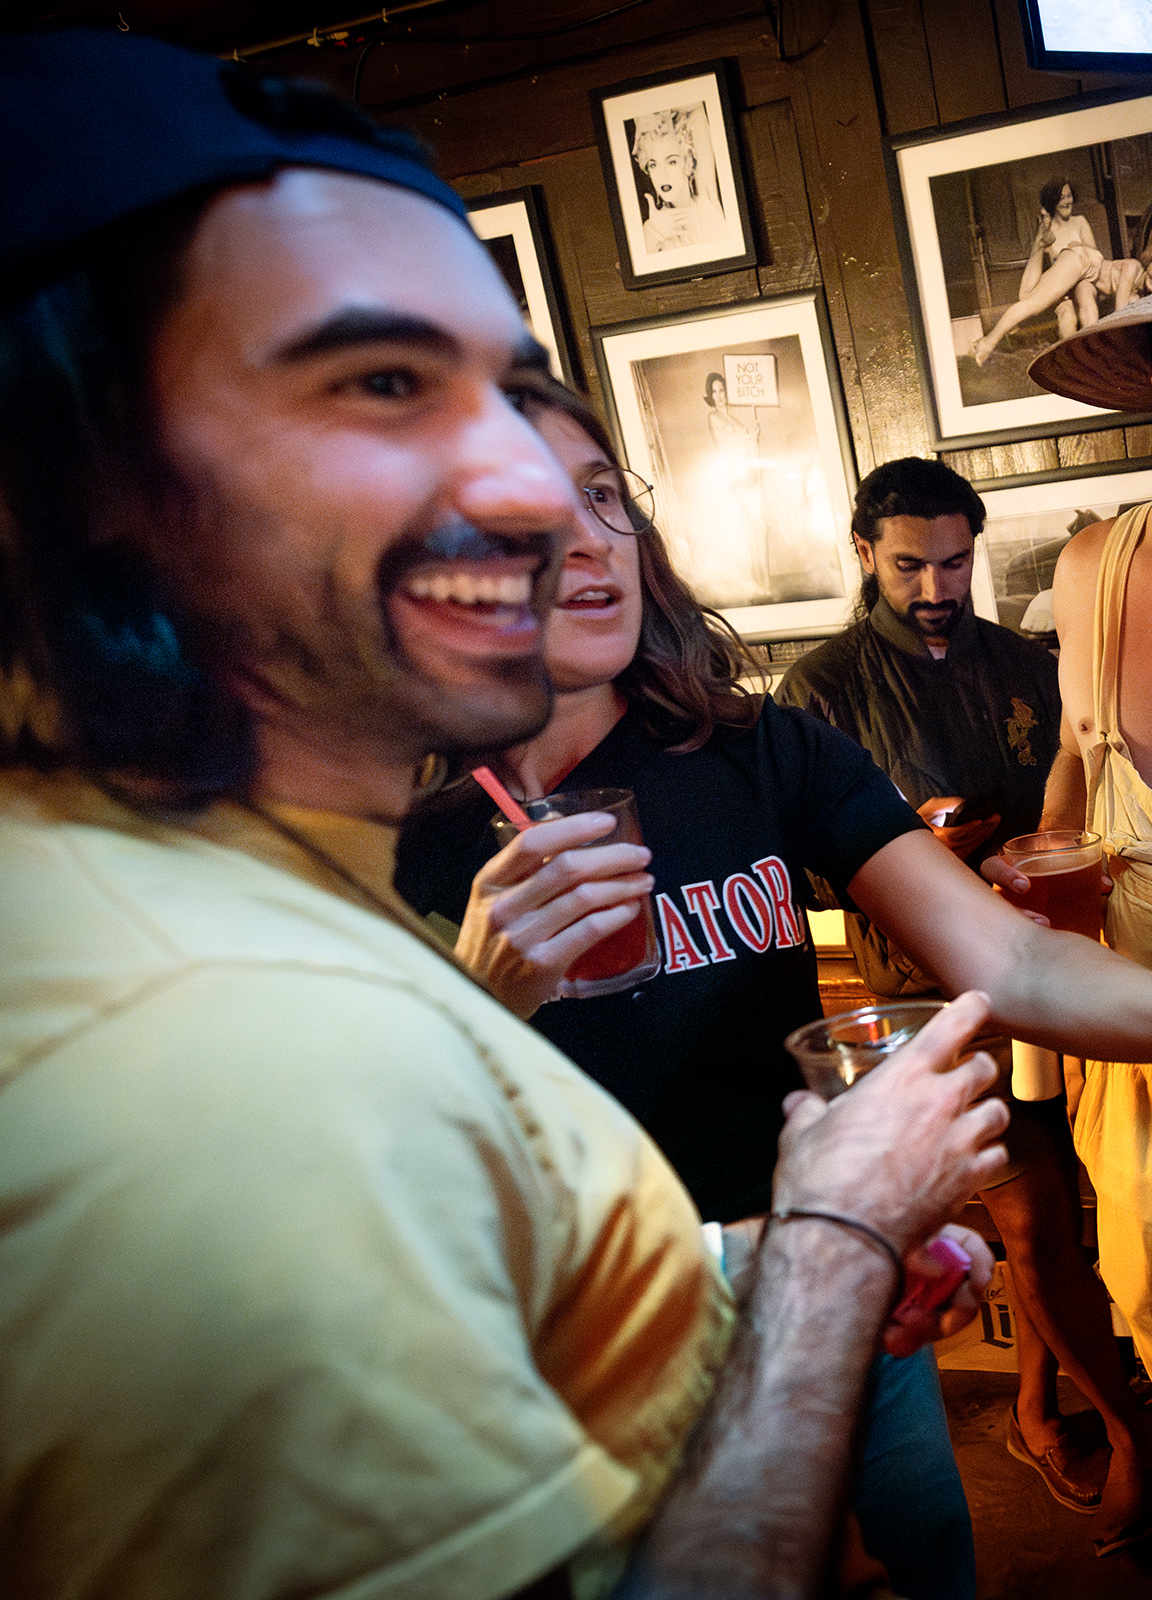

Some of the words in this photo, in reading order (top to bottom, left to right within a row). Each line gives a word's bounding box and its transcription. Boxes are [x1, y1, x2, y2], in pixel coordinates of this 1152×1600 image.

[737, 362, 758, 373] NOT
[735, 373, 763, 385] YOUR
[736, 385, 765, 398] BITCH
